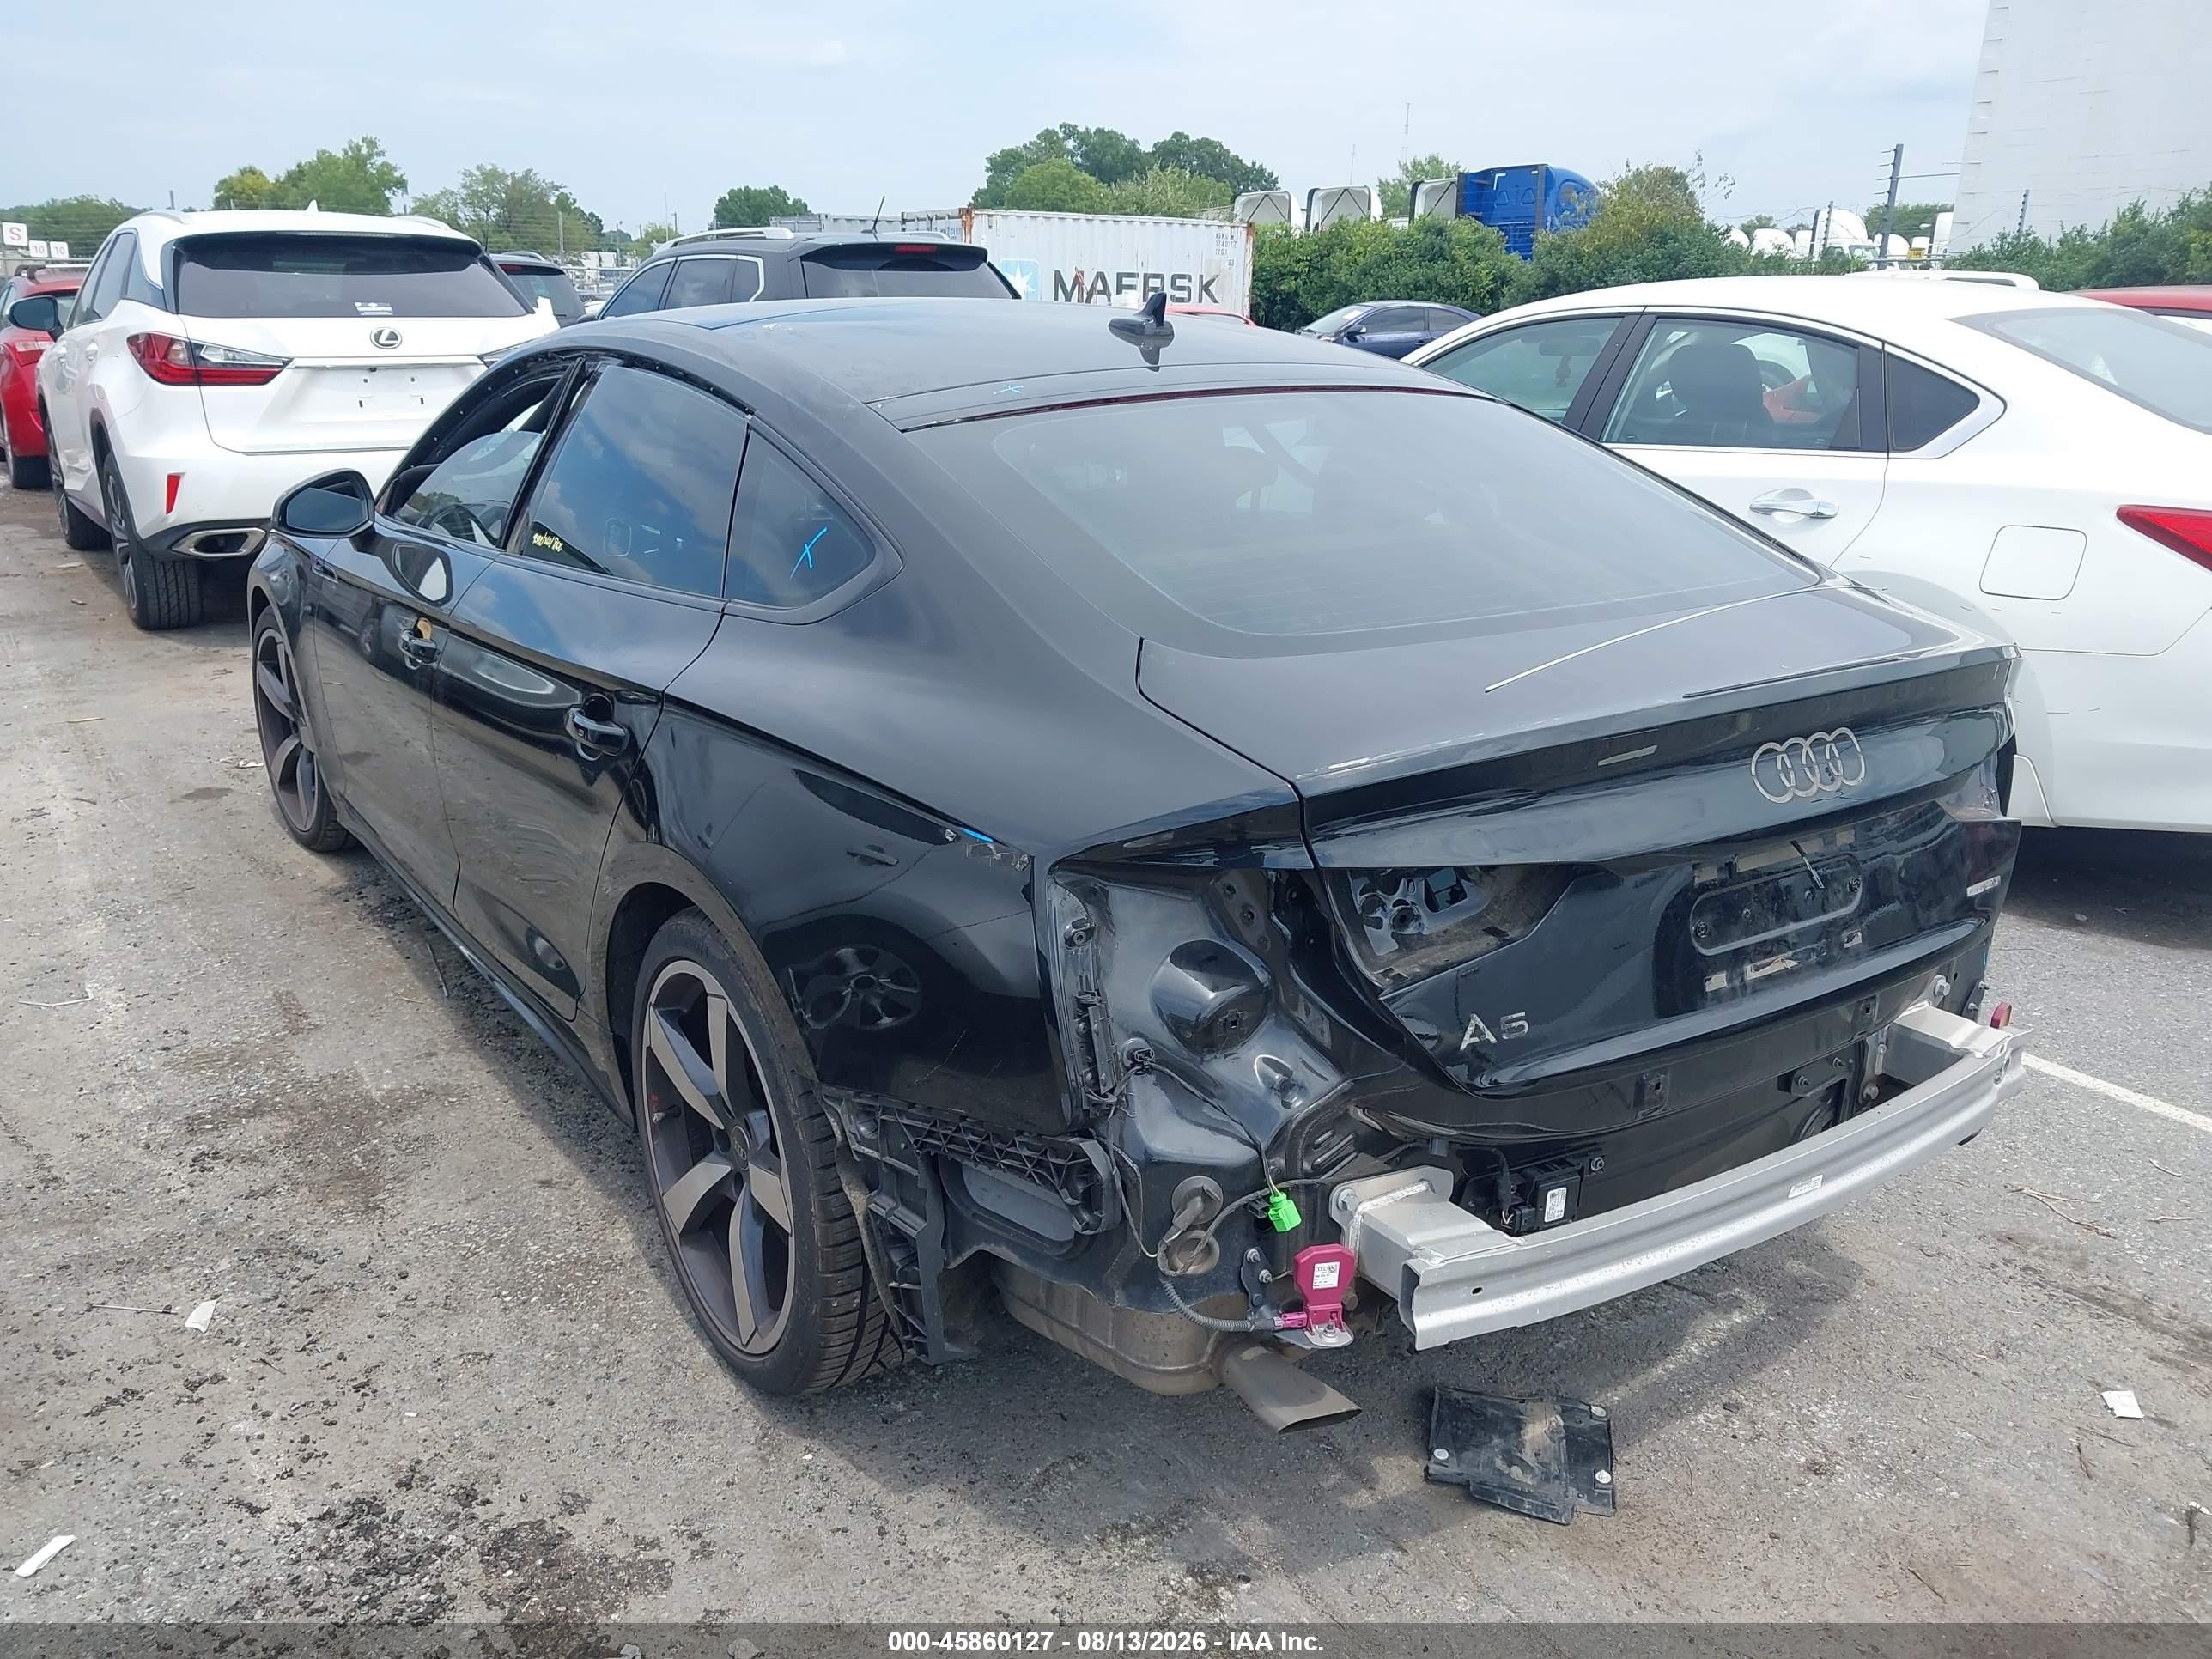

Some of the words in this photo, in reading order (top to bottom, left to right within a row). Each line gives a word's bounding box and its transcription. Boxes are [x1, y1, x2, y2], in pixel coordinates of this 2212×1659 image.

[9, 227, 21, 240] S
[33, 246, 45, 254] 10
[54, 246, 65, 255] 10
[1460, 1012, 1528, 1051] A5
